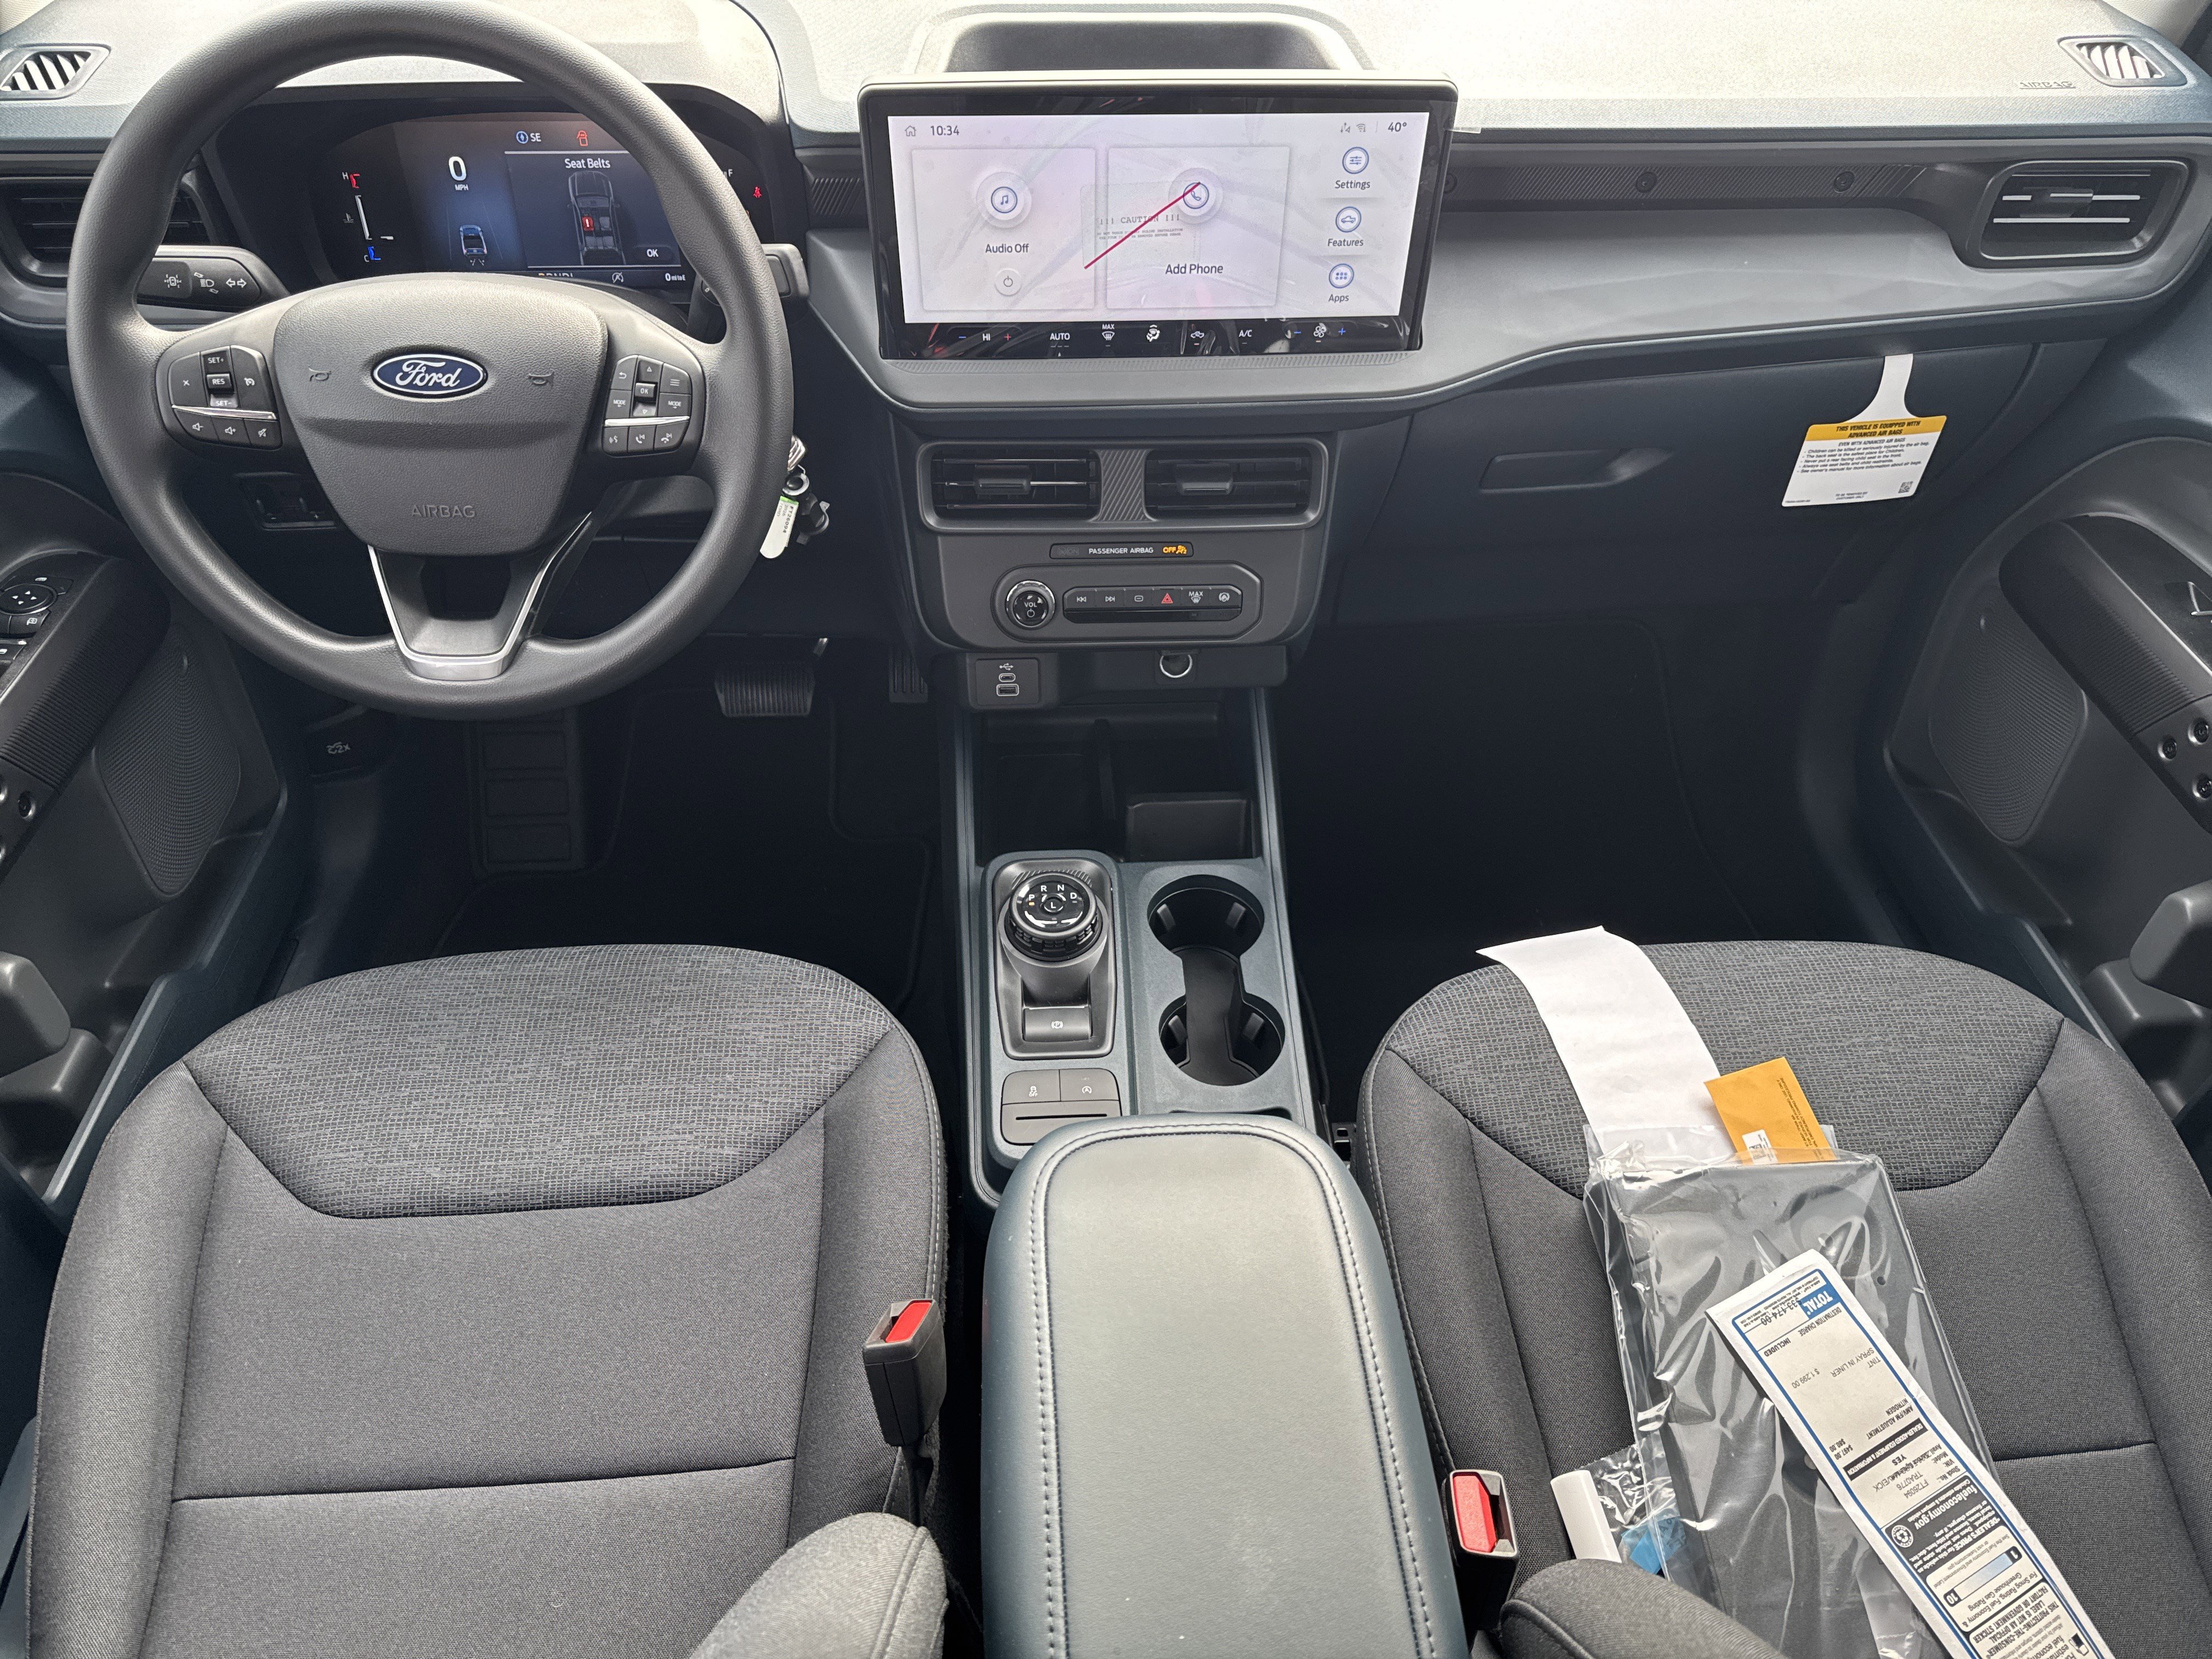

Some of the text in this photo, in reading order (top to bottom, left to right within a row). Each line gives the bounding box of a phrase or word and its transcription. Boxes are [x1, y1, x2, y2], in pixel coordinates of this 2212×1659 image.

[930, 125, 960, 136] 10:34
[1388, 122, 1407, 132] 40°
[531, 133, 541, 142] SE
[448, 156, 467, 181] 0
[565, 158, 611, 169] Seat Belts
[1335, 180, 1370, 190] Settings
[985, 244, 1029, 253] Audio Off
[1328, 238, 1364, 247] Features
[646, 249, 658, 257] OK
[1165, 263, 1223, 275] Add Phone
[665, 273, 670, 281] 0
[1329, 294, 1349, 303] Apps
[1050, 333, 1070, 341] AUTO
[396, 359, 463, 387] Ford
[411, 505, 476, 518] AIRBAG
[782, 505, 793, 533] FT26094
[1763, 1306, 1842, 1357] DESTINATION CHARGE INCLUDED
[1830, 1346, 1874, 1378] SPRAY IN LINER
[1866, 1356, 1880, 1368] TINT
[1884, 1398, 1909, 1416] NITROGEN
[1833, 1405, 1914, 1460] AMV/FM ADJUSTMENT $497.00
[1894, 1423, 1923, 1444] DEALER-ADDED
[1874, 1440, 1897, 1458] EQUIPMENT
[1847, 1455, 1873, 1475] INFORMATION
[1891, 1453, 1906, 1466] YES
[1895, 1451, 1948, 1491] Model: TRA0776
[1945, 1465, 1960, 1477] Stock
[1903, 1457, 1954, 1499] VIN: FT26094
[1912, 1483, 1978, 1530] fueleconomy.gov
[1953, 1534, 1973, 1550] PRICE
[2010, 1549, 2019, 1560] 1
[1912, 1559, 1923, 1568] and
[2028, 1571, 2038, 1581] For
[2014, 1576, 2030, 1590] Smog
[1967, 1571, 2022, 1612] Greenhouse Gas Rating
[1997, 1585, 2017, 1601] Rating,
[1945, 1592, 1959, 1605] 10
[1989, 1598, 2001, 1609] Fuel
[2046, 1600, 2059, 1612] THIS
[1966, 1604, 1991, 1624] Economy
[1972, 1585, 2049, 1644] FACTORY OR GOVERNMENT STICKER
[1988, 1599, 2045, 1644] LABEL IS NOT AN OFFICIAL
[2051, 1635, 2065, 1648] fuel
